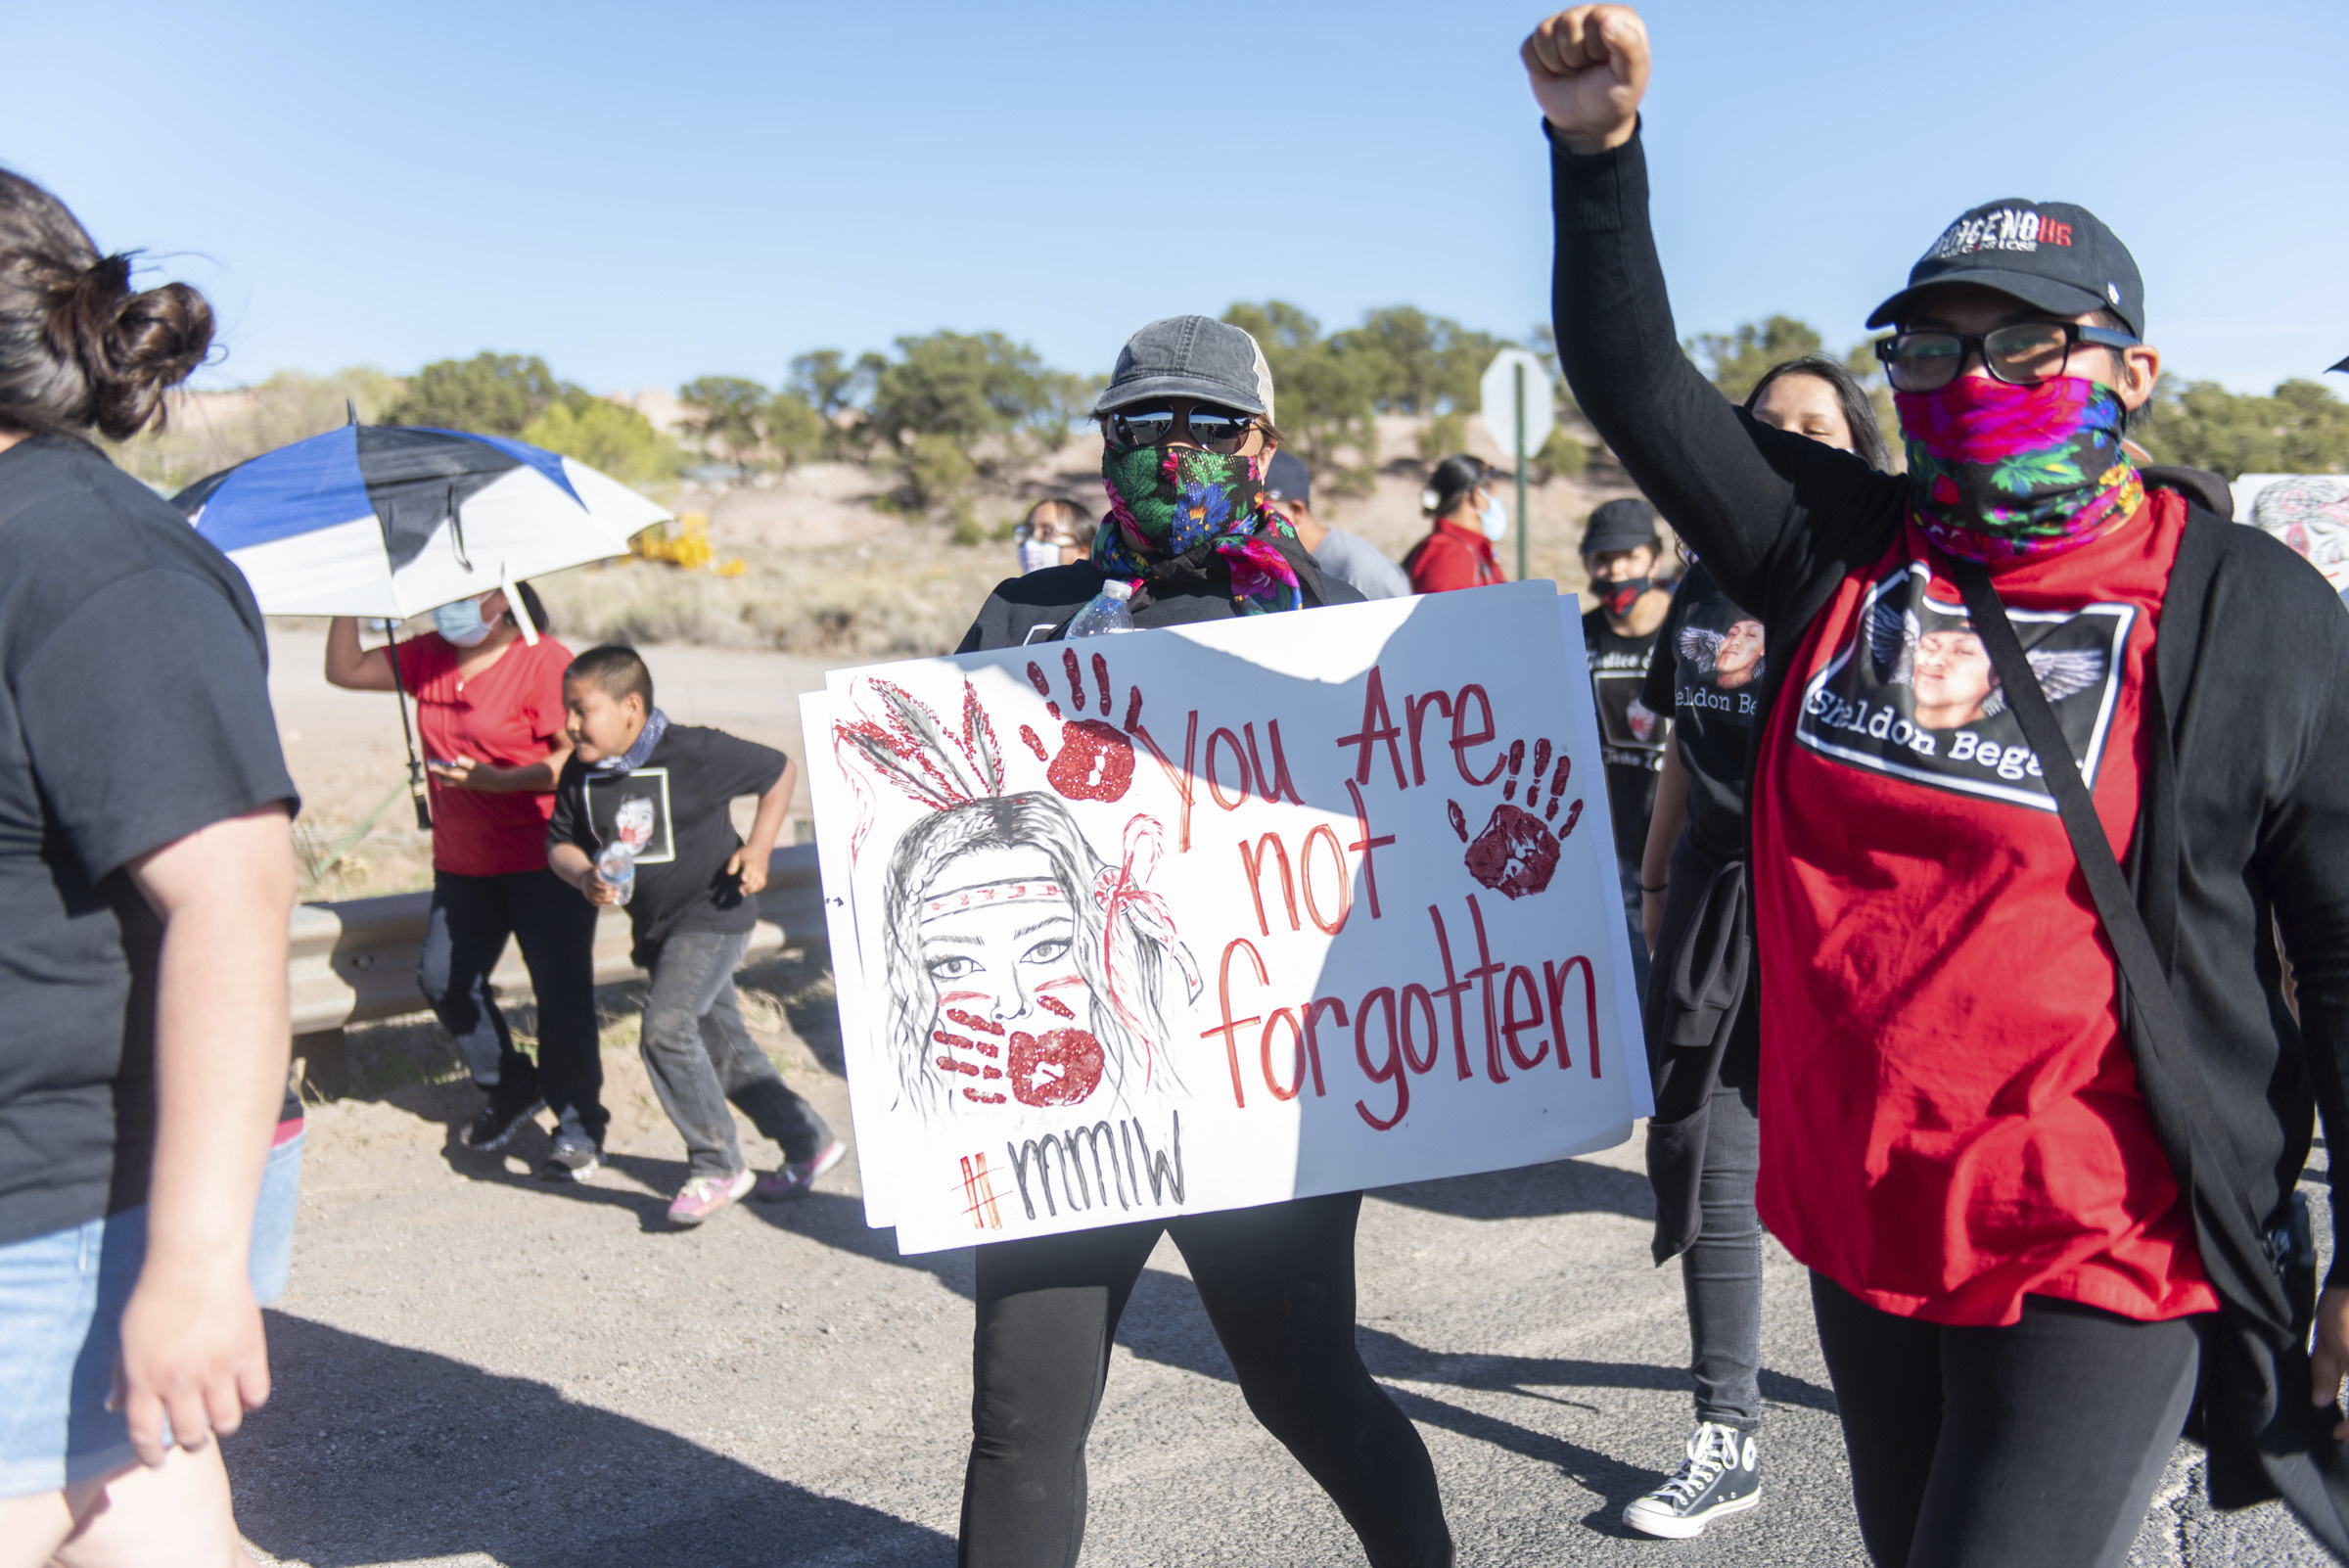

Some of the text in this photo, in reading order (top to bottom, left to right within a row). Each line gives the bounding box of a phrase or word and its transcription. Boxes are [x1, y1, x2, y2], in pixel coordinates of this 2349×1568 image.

[1134, 666, 1507, 853] You Are
[1676, 686, 1730, 712] eldon
[1238, 778, 1396, 937] not
[1200, 894, 1602, 1131] forgotten
